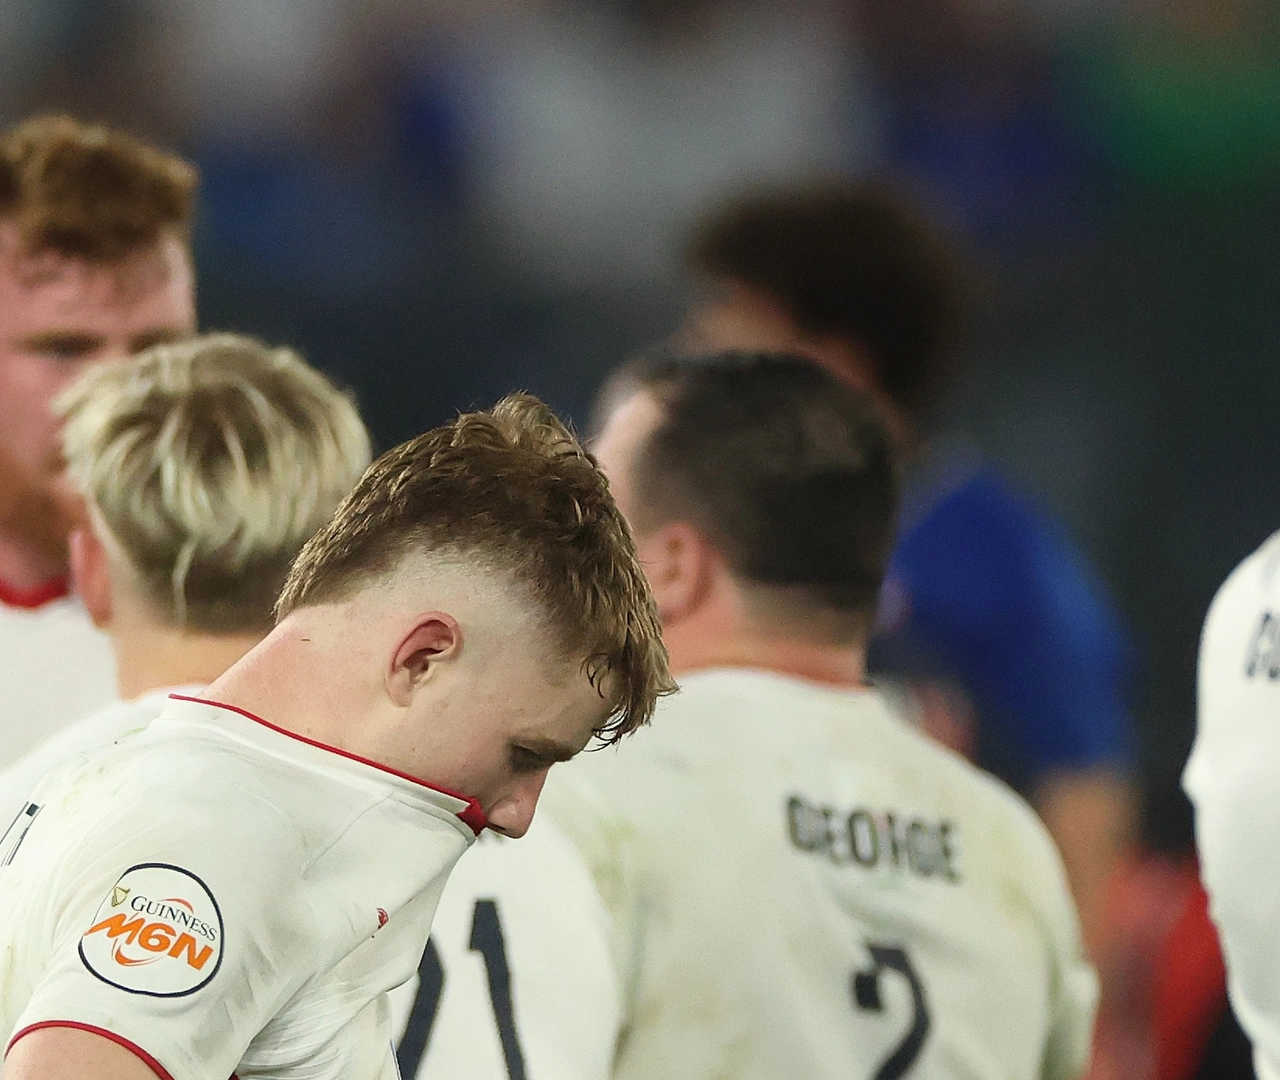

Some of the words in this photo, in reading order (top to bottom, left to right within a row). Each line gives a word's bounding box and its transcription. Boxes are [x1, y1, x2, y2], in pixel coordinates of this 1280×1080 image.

[789, 796, 960, 883] GEORGE
[83, 913, 214, 971] M6N
[131, 895, 217, 941] GUINNESS
